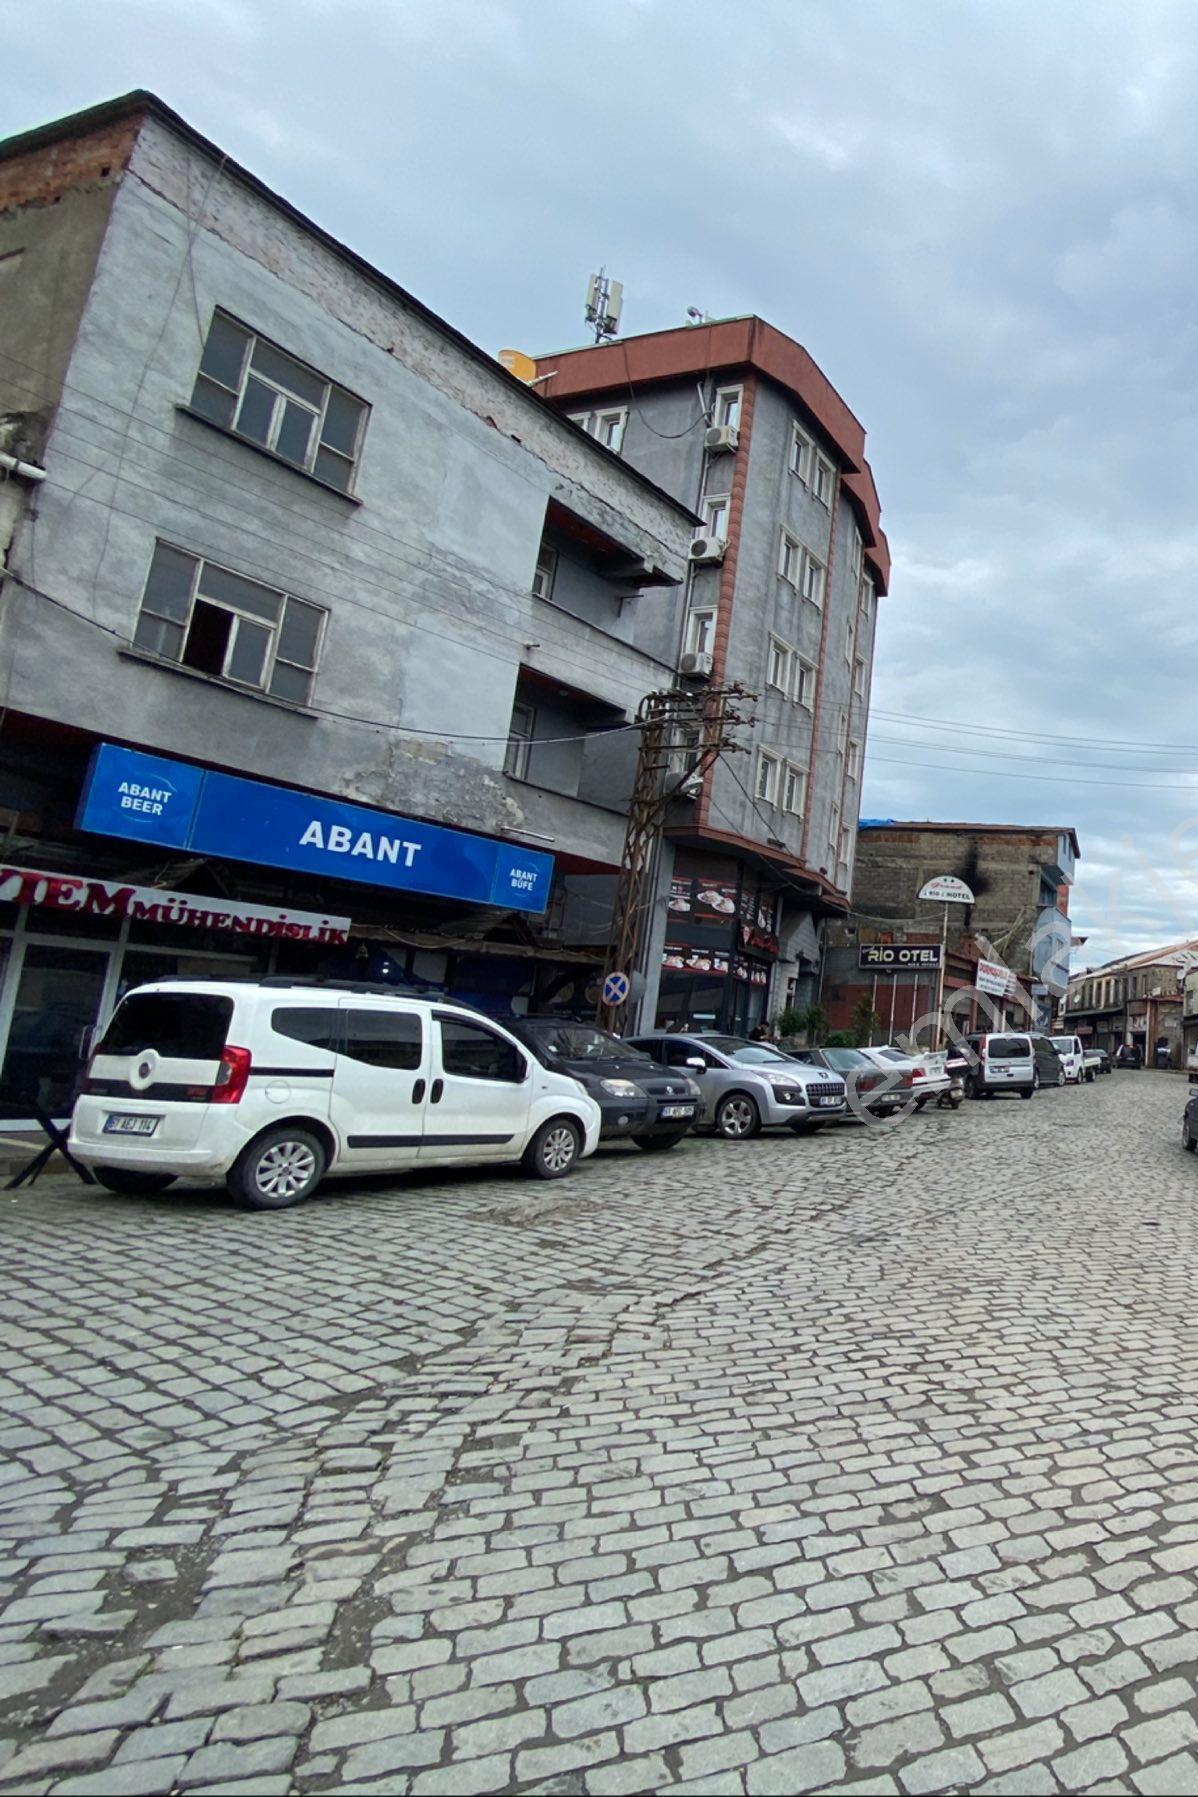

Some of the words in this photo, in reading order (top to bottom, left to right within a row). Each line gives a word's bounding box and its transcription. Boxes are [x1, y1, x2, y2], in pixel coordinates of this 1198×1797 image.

[117, 781, 173, 804] ABANT
[120, 796, 163, 816] BEER
[299, 820, 422, 867] ABANT
[509, 867, 538, 882] ABANT
[133, 898, 348, 945] MÜHENDİSLİK
[867, 946, 895, 962] RİO
[898, 949, 938, 962] OTEL
